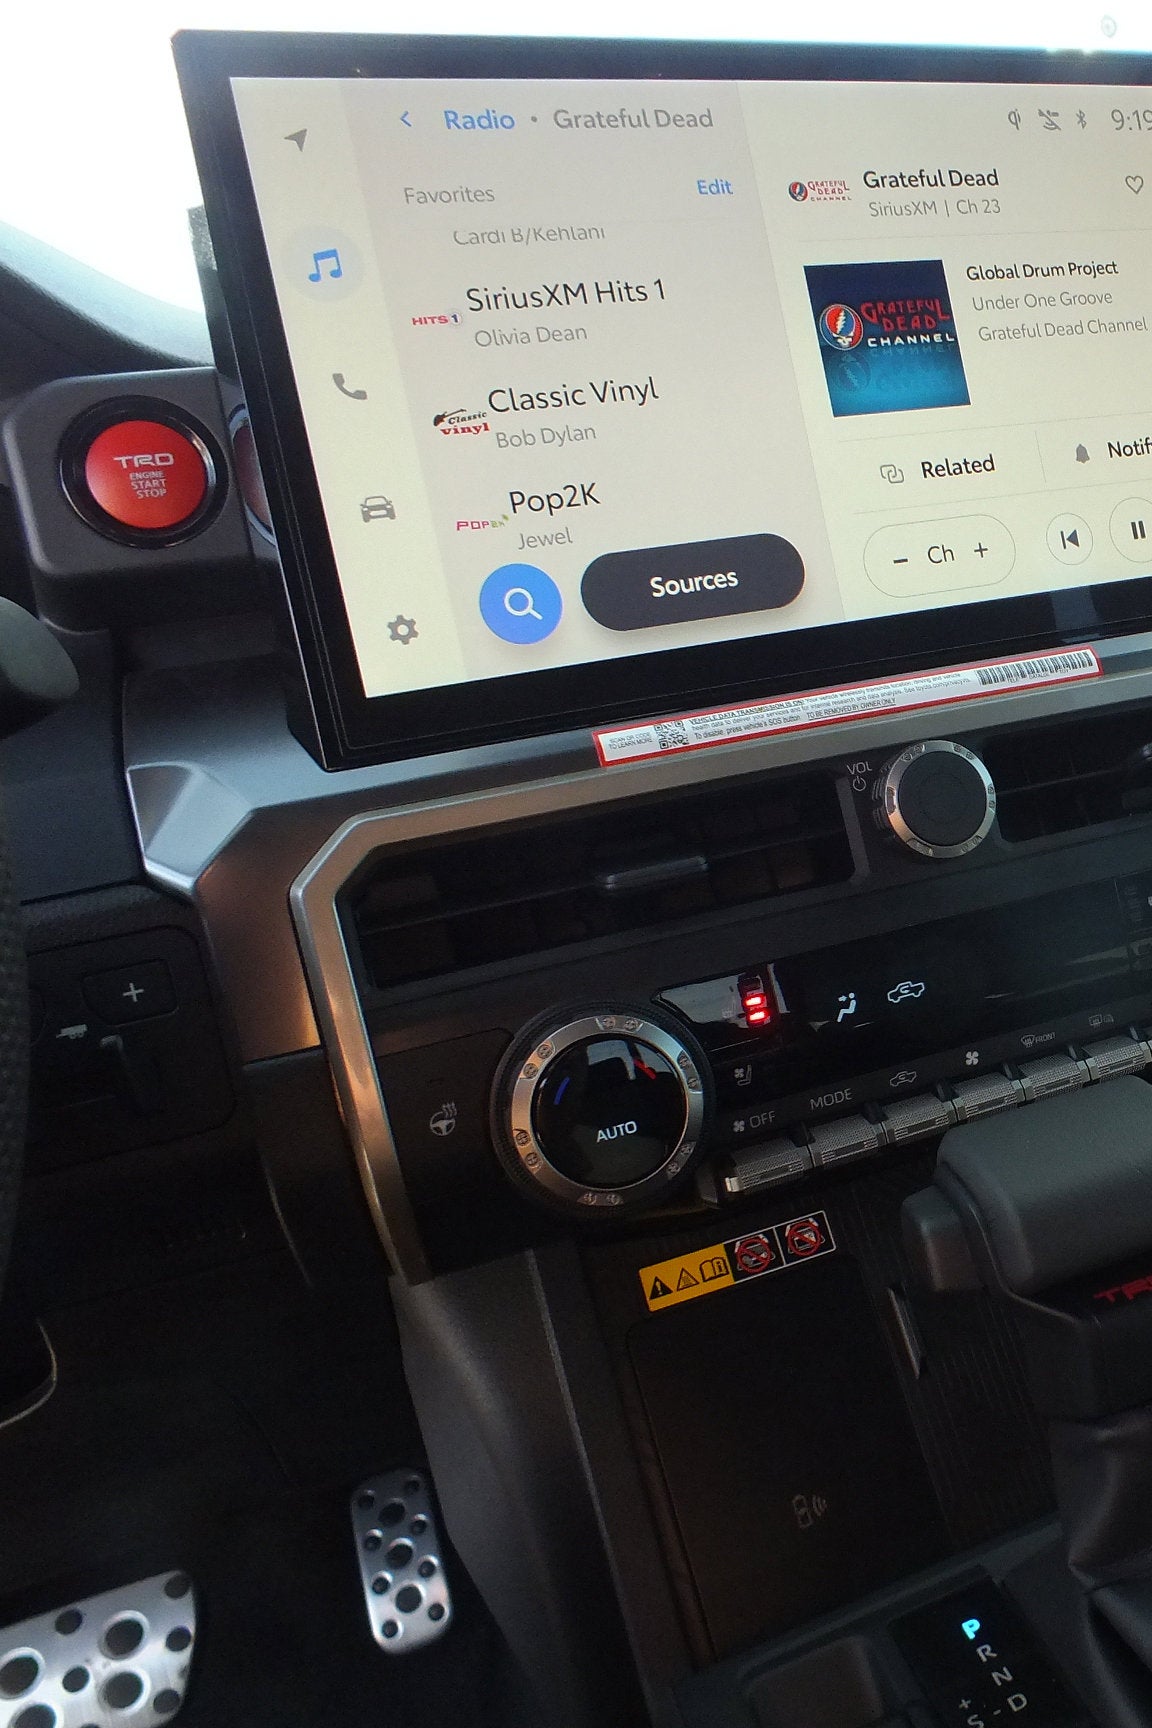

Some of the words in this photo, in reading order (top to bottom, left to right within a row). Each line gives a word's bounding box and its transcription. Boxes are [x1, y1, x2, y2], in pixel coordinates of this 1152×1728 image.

[444, 109, 516, 131] Radio
[552, 107, 650, 130] Grateful
[656, 108, 713, 129] Dead
[697, 178, 734, 196] Edit
[863, 168, 945, 190] Grateful
[949, 168, 999, 187] Dead
[404, 184, 495, 206] Favorites
[817, 187, 844, 195] DEAD
[868, 200, 938, 217] SiriusXM
[956, 199, 978, 215] Ch
[981, 198, 1000, 214] 23
[966, 263, 1020, 282] Global
[1023, 263, 1065, 279] Drum
[1068, 261, 1119, 280] Project
[466, 282, 589, 313] SiriusXM
[595, 280, 649, 305] Hits
[654, 278, 666, 300] 1
[972, 294, 1020, 312] Under
[1024, 293, 1057, 309] One
[1060, 291, 1113, 307] Groove
[412, 315, 449, 326] HITS
[860, 298, 950, 324] GRATEFUL
[882, 314, 937, 332] DEAD
[978, 323, 1043, 343] Grateful
[1045, 321, 1085, 338] Dead
[1087, 317, 1149, 336] Channel
[475, 327, 531, 349] Olivia
[536, 324, 588, 344] Dean
[867, 333, 955, 348] CHANNEL
[488, 383, 587, 414] Classic
[590, 375, 660, 406] Vinyl
[440, 422, 490, 435] vinyl
[495, 427, 536, 449] Bob
[541, 423, 597, 447] Dylan
[113, 452, 175, 469] TRD
[921, 454, 996, 480] Related
[129, 470, 164, 481] ENGINE
[131, 479, 167, 490] START
[136, 488, 167, 499] STOP
[509, 482, 601, 516] Pop2K
[517, 526, 573, 550] Jewel
[927, 544, 955, 565] Ch
[650, 569, 739, 598] Sources
[847, 761, 872, 775] VOL
[810, 1088, 852, 1111] MODE
[749, 1110, 776, 1129] OFF
[596, 1120, 638, 1144] AUTO
[961, 1618, 981, 1640] P
[976, 1643, 998, 1662] R
[991, 1666, 1013, 1686] N
[1007, 1693, 1028, 1712] D
